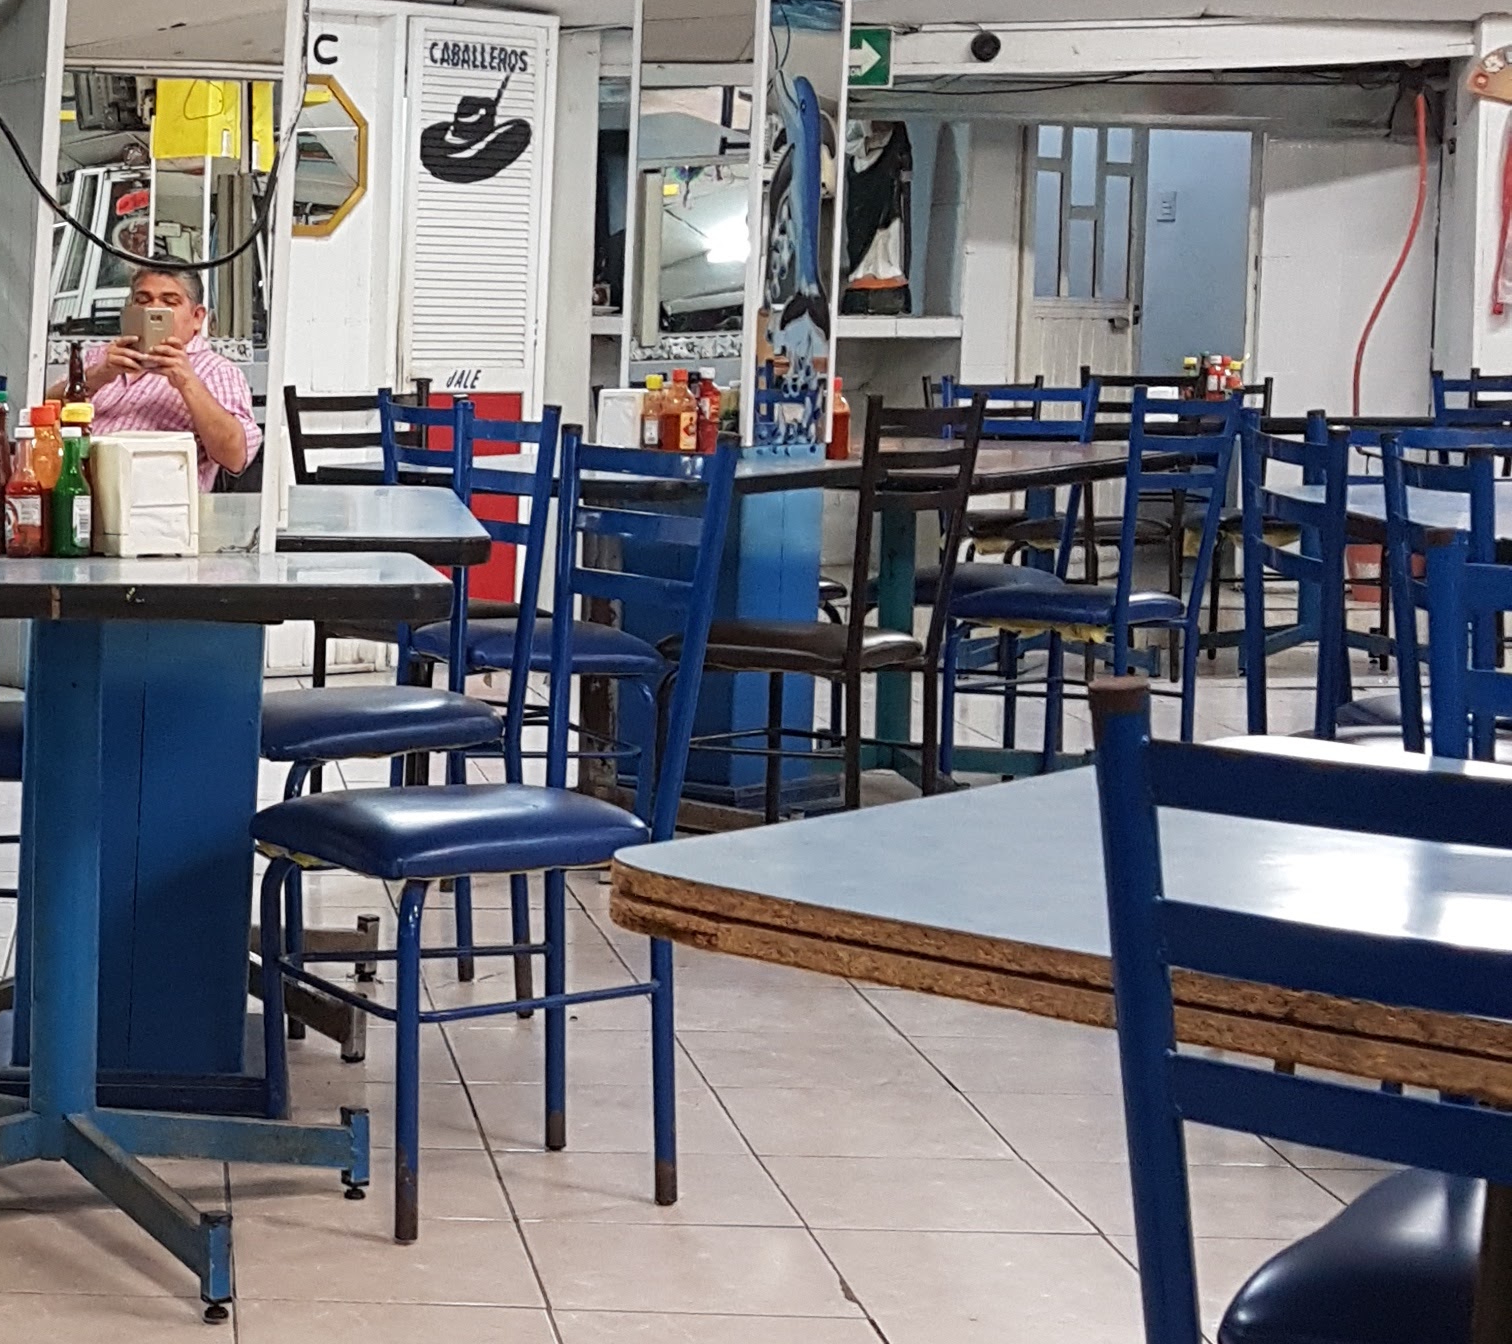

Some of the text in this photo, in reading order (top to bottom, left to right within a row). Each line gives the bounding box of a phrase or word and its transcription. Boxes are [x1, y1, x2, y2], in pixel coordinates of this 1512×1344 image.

[313, 33, 339, 65] C
[429, 41, 528, 73] CABALLEROS
[446, 369, 482, 389] JALE
